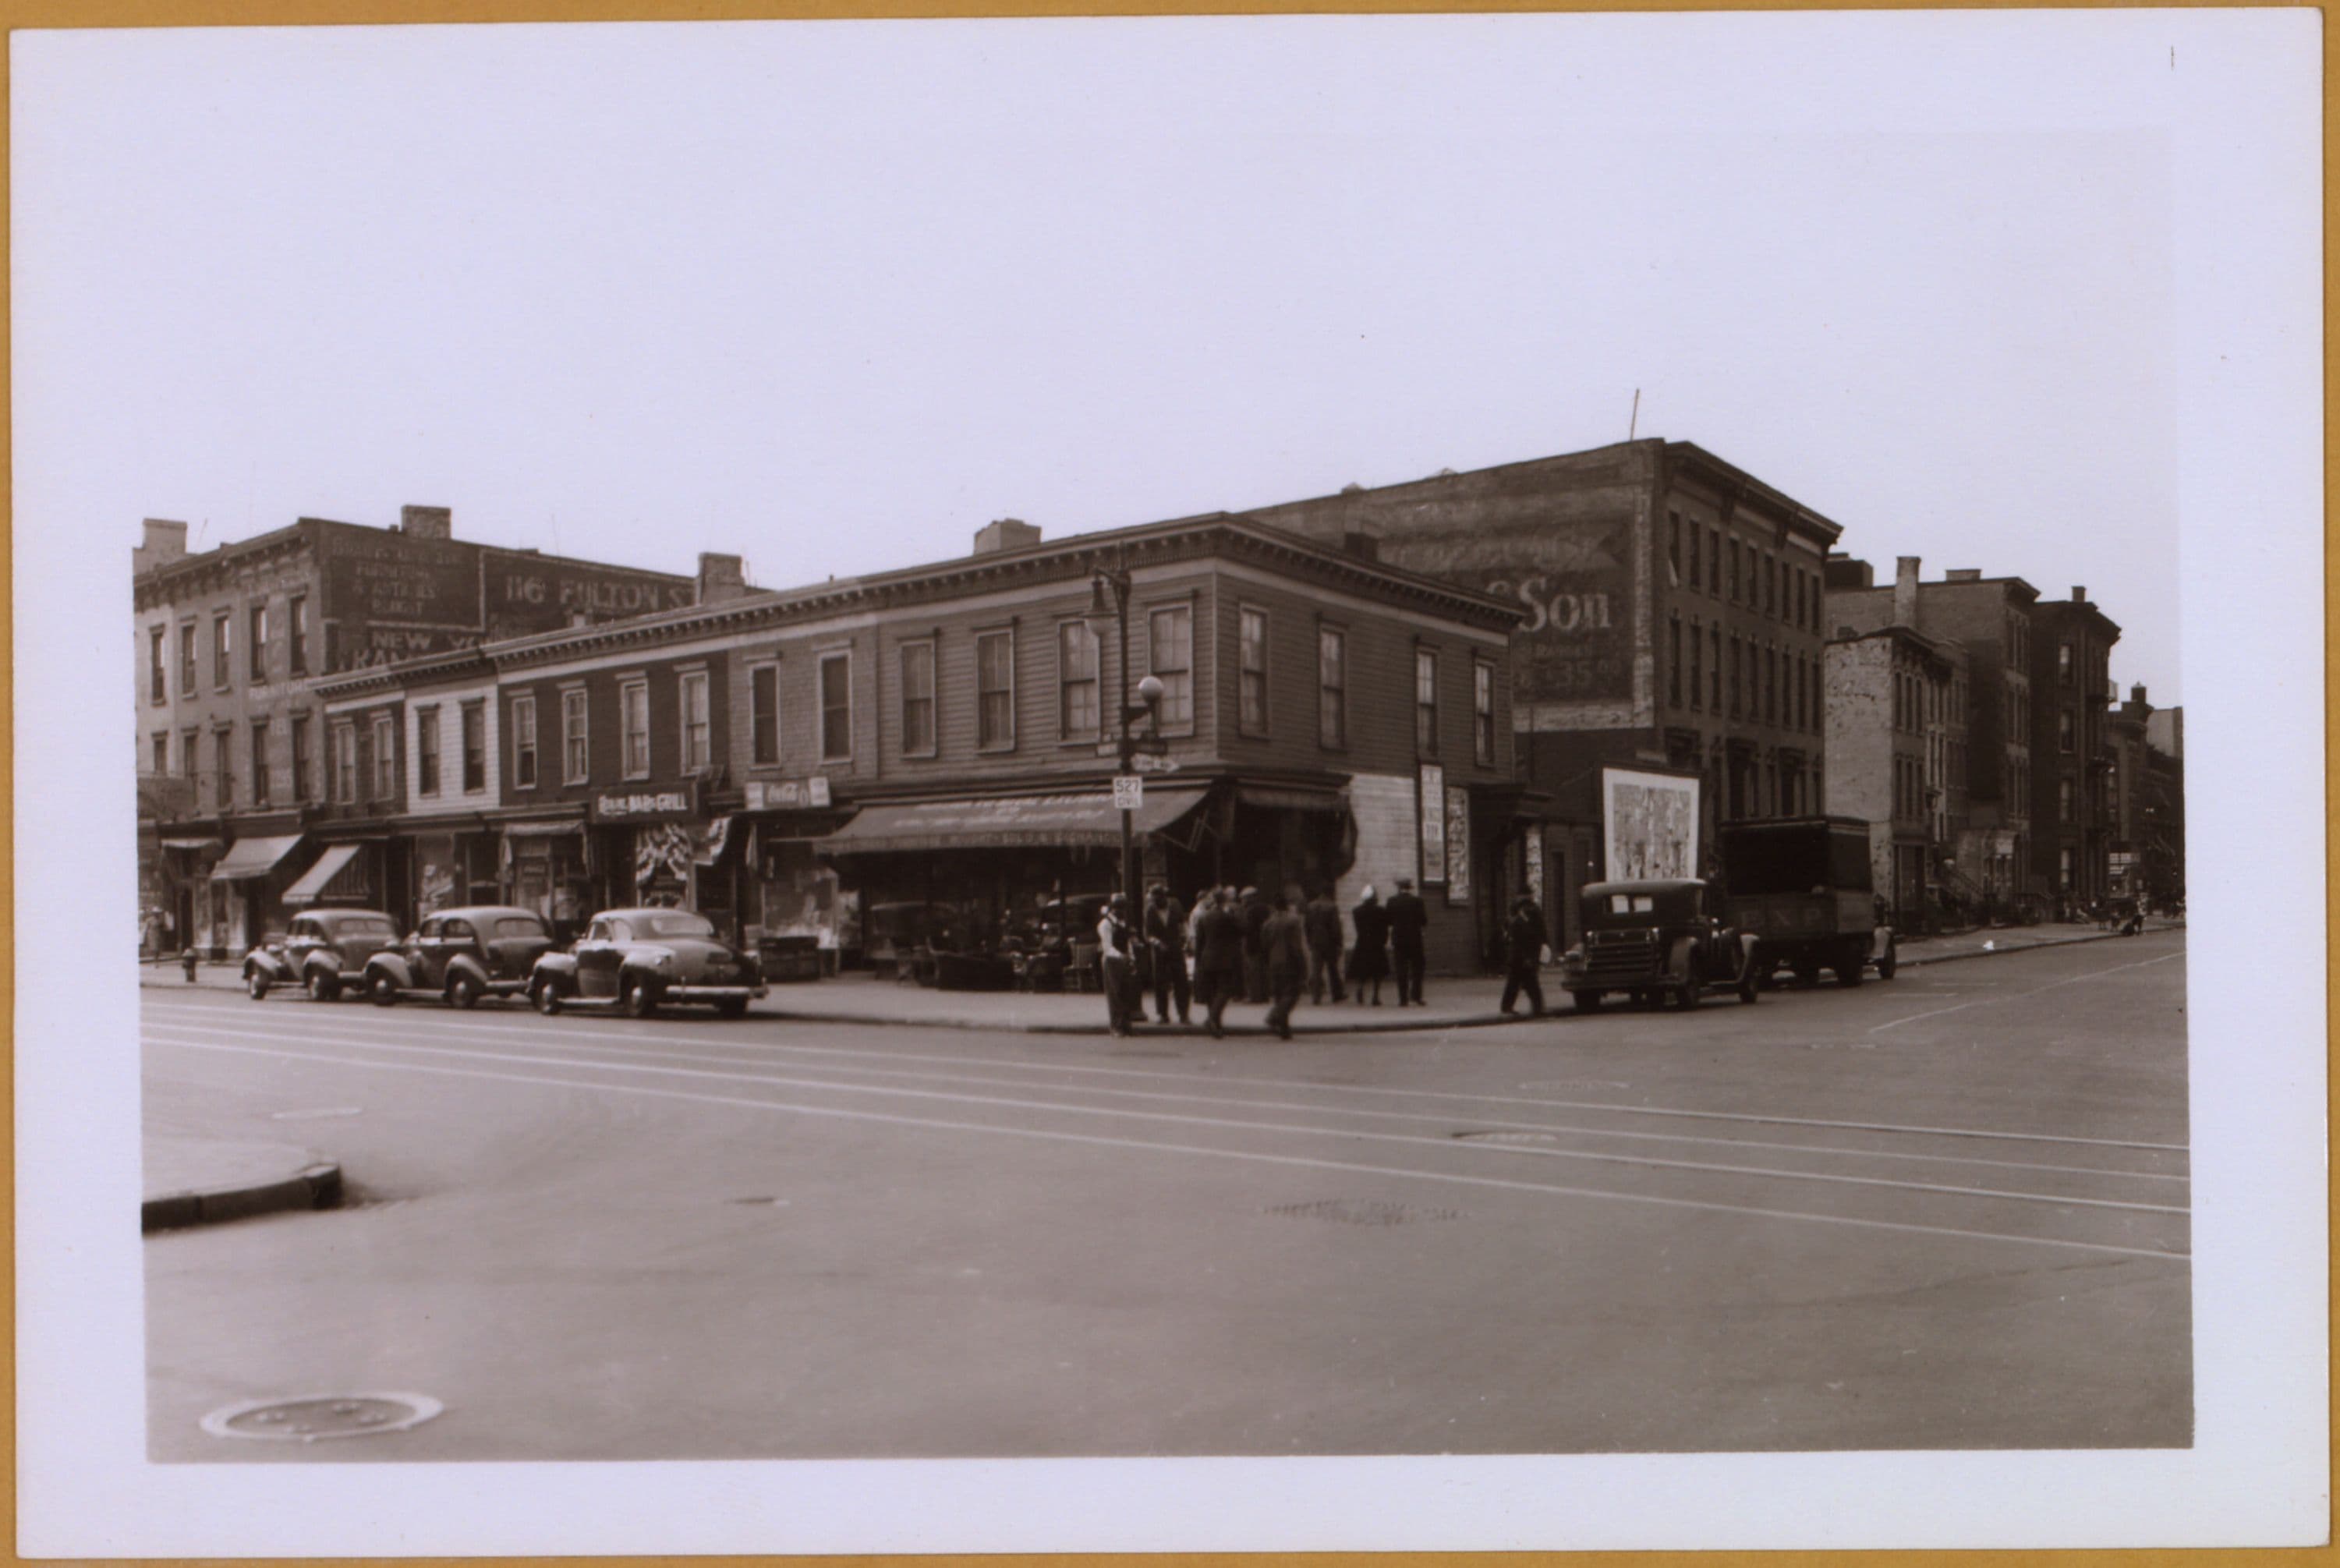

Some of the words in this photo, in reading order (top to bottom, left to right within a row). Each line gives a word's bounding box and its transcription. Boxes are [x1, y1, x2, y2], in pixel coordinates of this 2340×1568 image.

[558, 578, 660, 611] FULTON
[1519, 575, 1612, 633] Son
[372, 632, 430, 649] NEW
[1116, 779, 1138, 793] 527
[657, 792, 688, 811] GRILL
